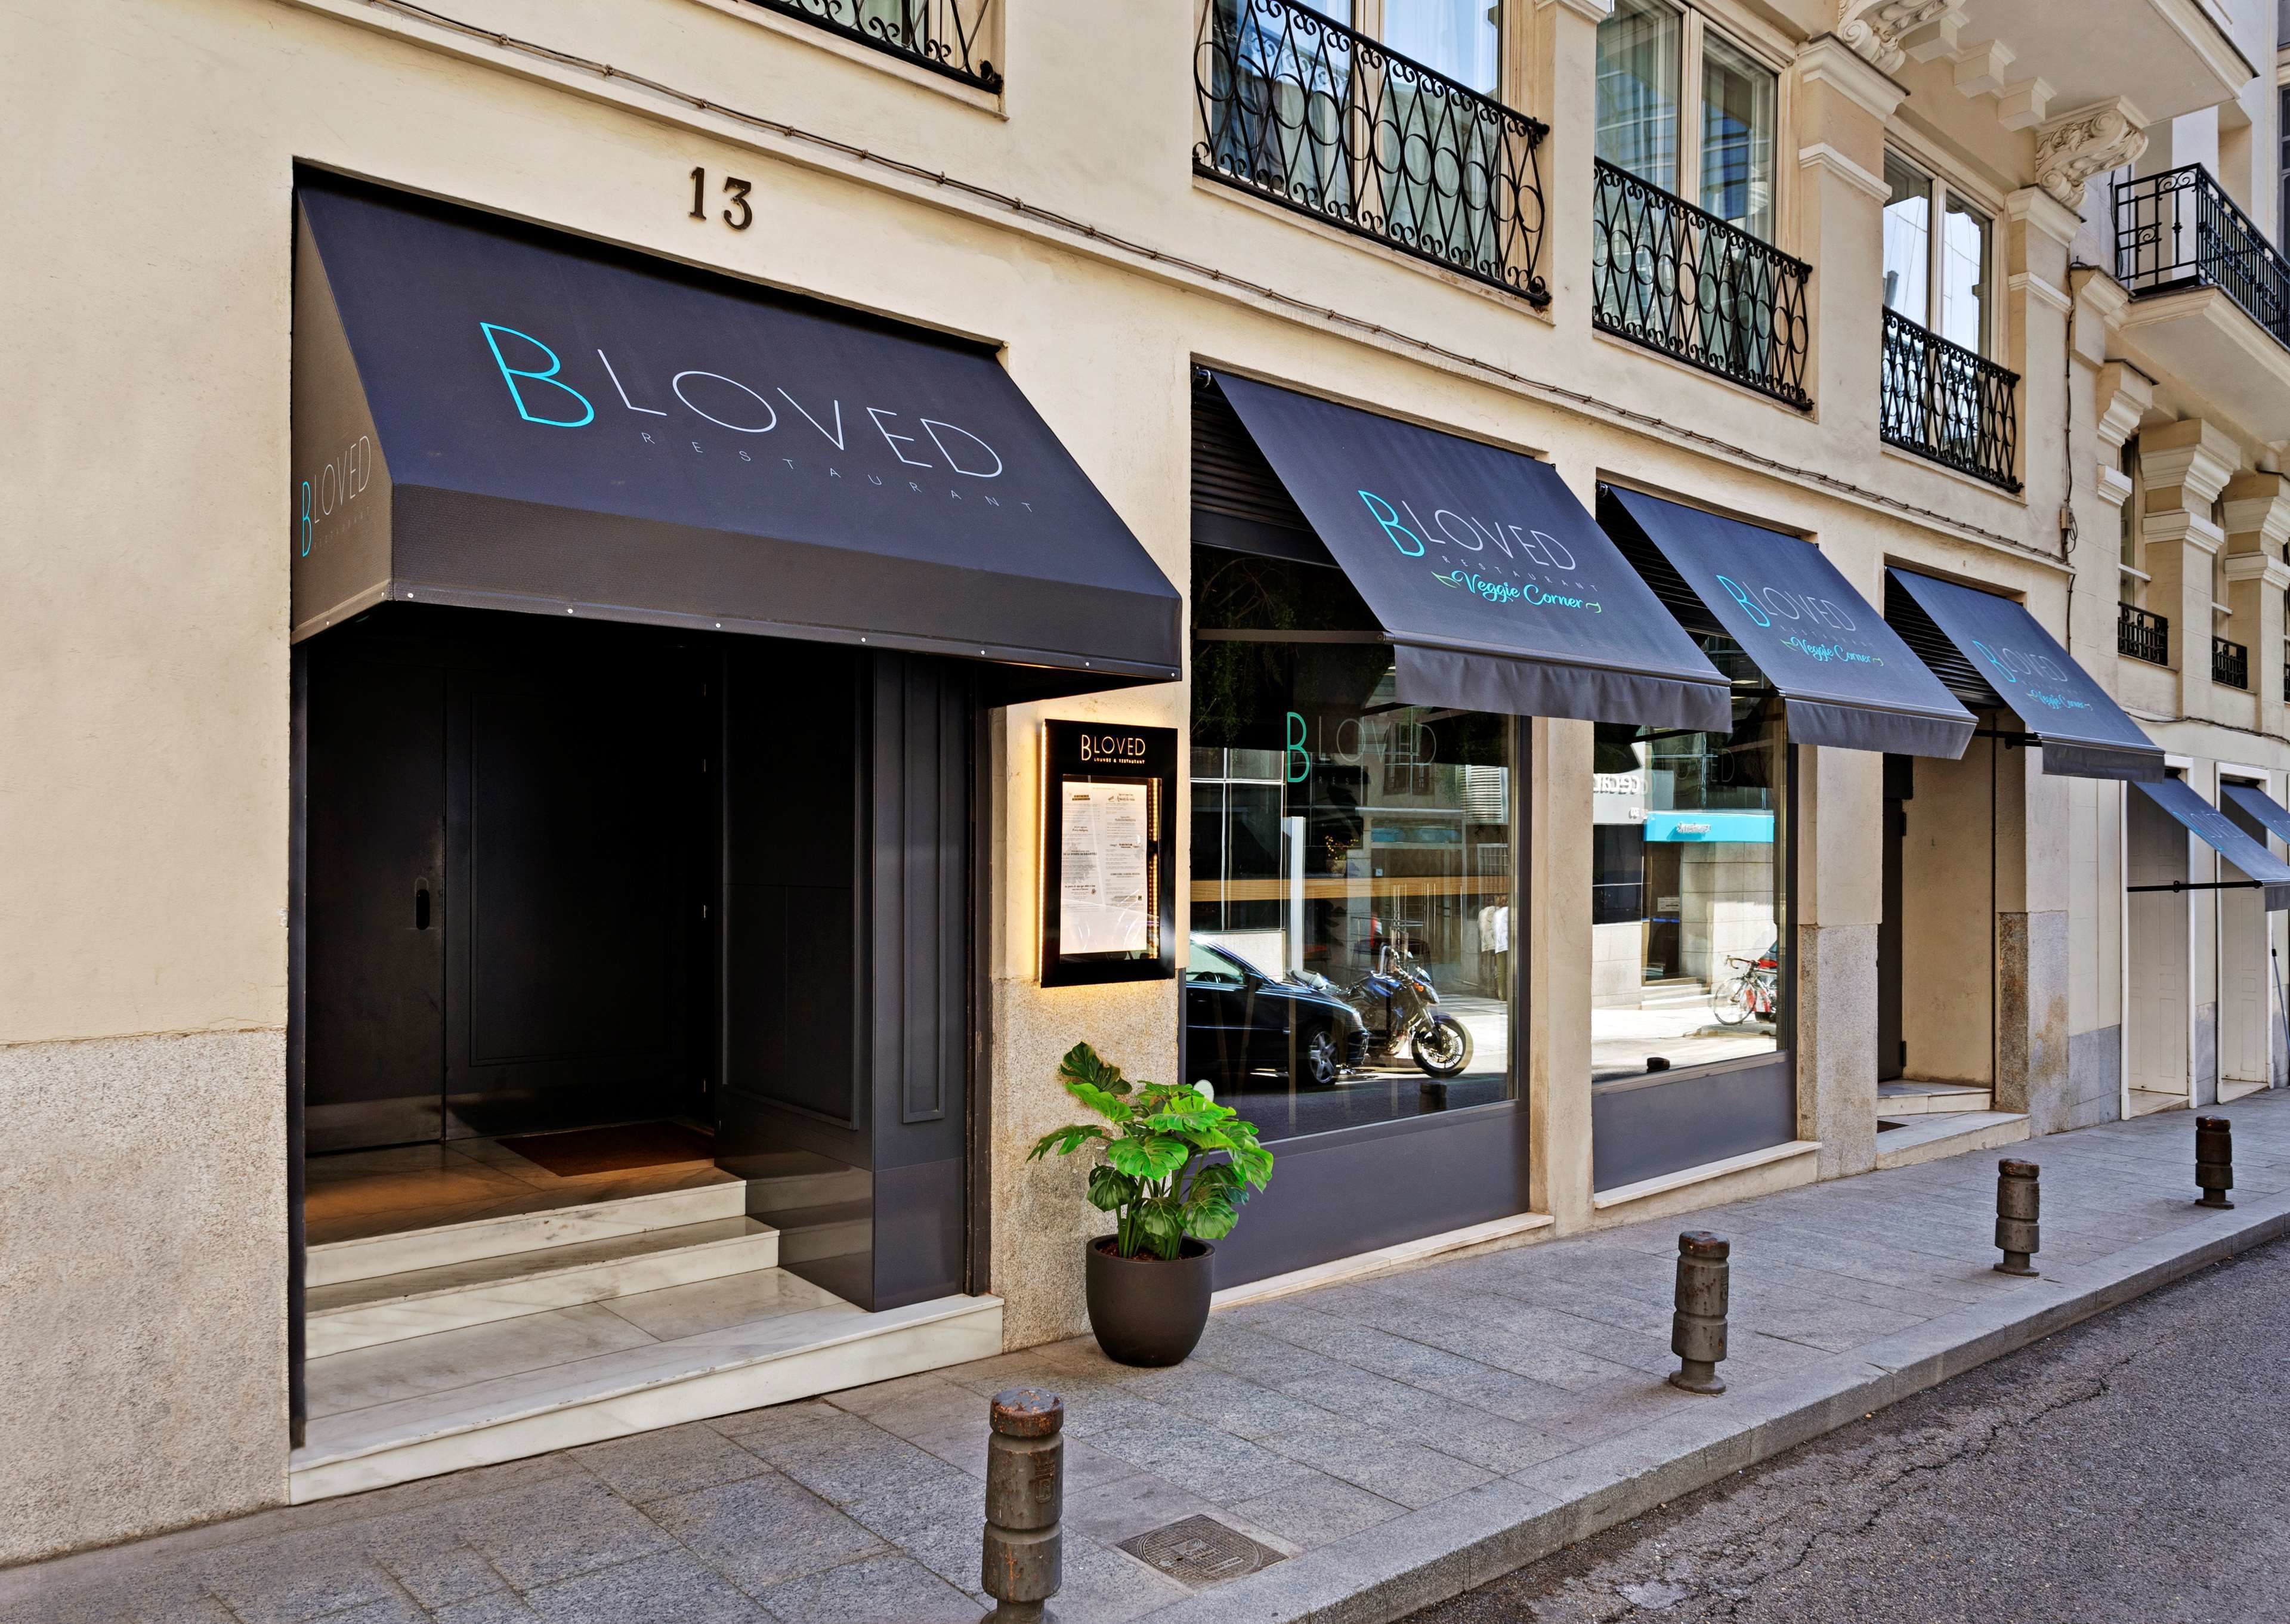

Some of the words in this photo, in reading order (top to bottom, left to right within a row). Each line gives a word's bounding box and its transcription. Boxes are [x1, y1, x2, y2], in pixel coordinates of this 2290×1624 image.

[689, 166, 754, 231] 13
[480, 323, 1003, 478] BLOVED
[302, 435, 372, 558] BLOVED
[641, 431, 1033, 513] RESTAURANT
[1358, 490, 1577, 571] BLOVED
[1441, 555, 1599, 592] RESTAURANT
[1451, 570, 1521, 604] Veggie
[1523, 583, 1584, 610] Corner
[1716, 574, 1856, 632] BLOVED
[1790, 636, 1834, 662] Veggie
[1834, 645, 1872, 664] Corner
[1971, 639, 2068, 683] BLOVED
[1081, 734, 1146, 761] BLOVED
[1286, 712, 1438, 783] BLOVD
